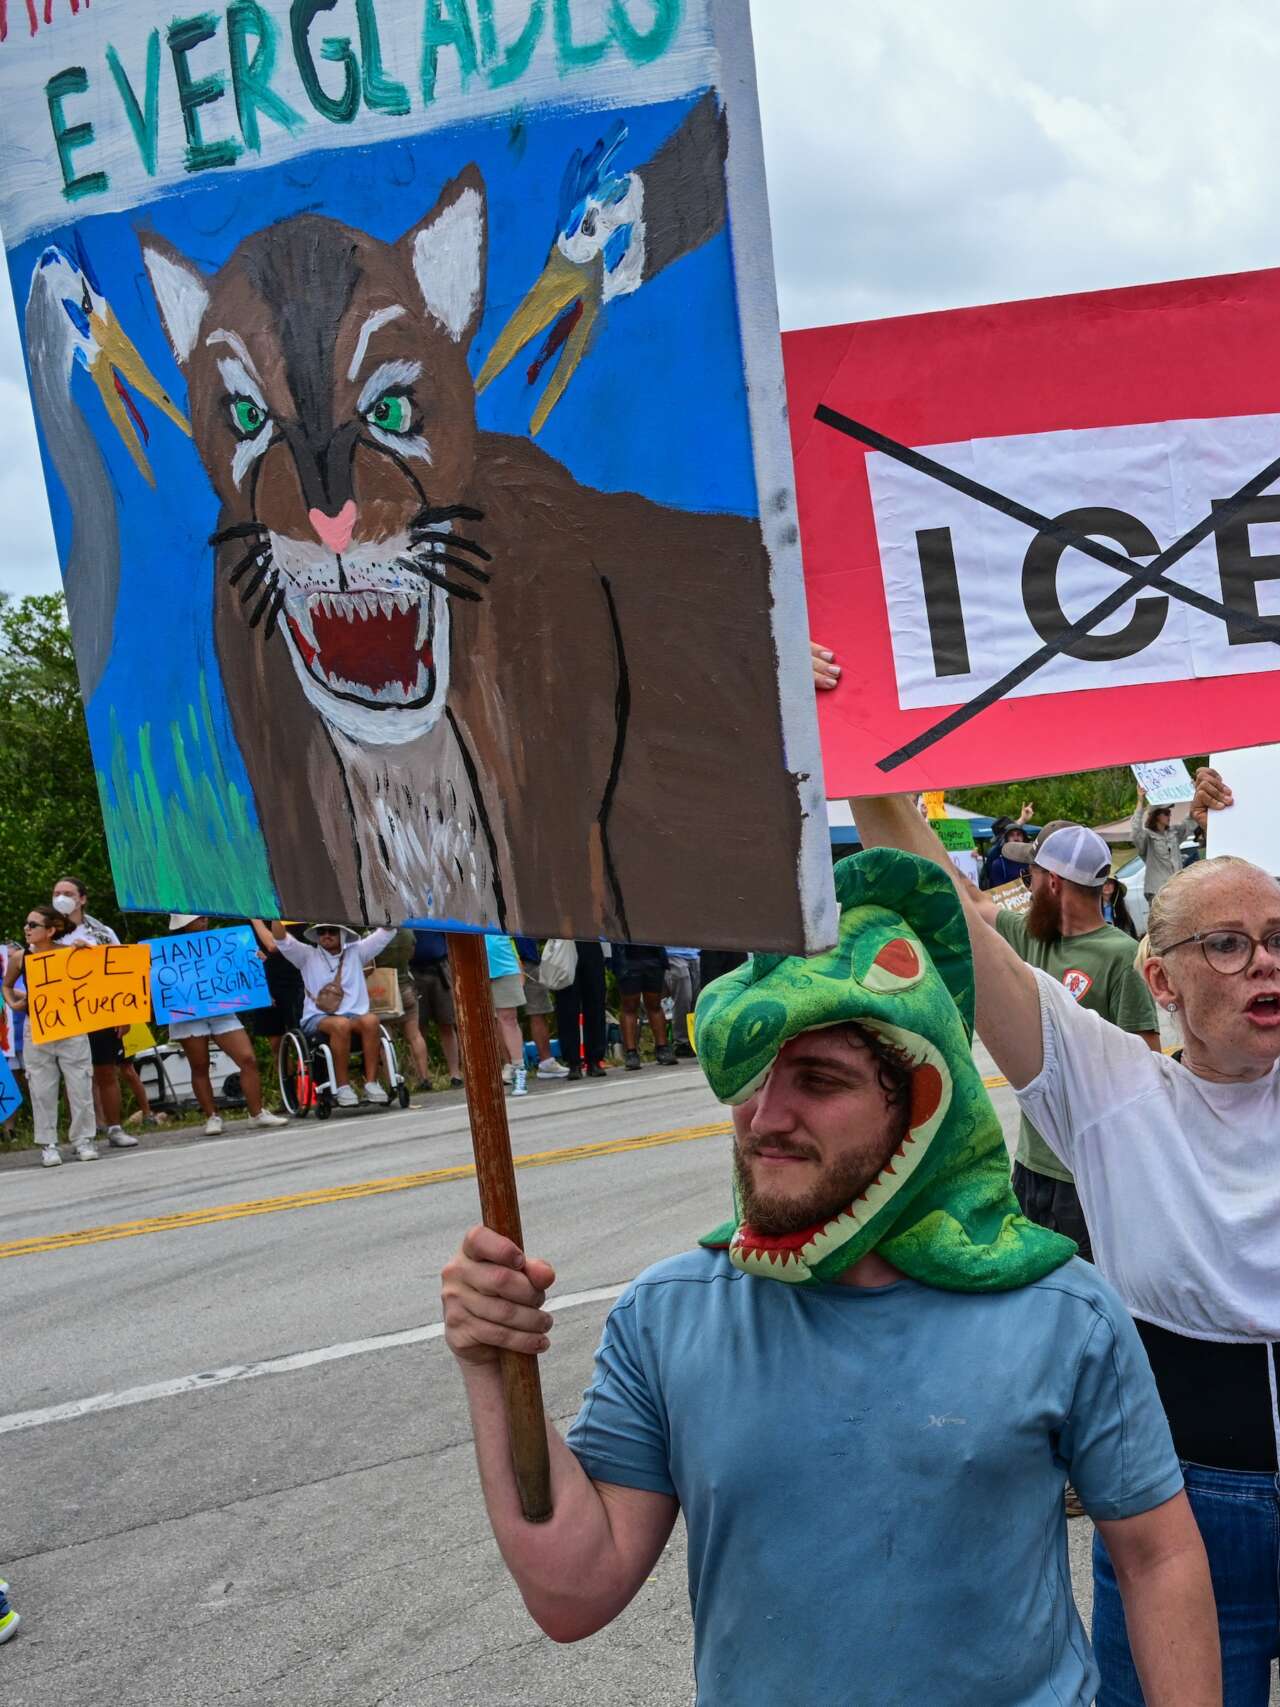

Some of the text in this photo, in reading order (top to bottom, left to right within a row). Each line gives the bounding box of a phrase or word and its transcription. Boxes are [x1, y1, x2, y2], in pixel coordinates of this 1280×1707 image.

[33, 945, 134, 988] ICE
[151, 931, 238, 966] HANDS
[157, 958, 206, 987] OFF
[73, 975, 148, 1022] Fuera!
